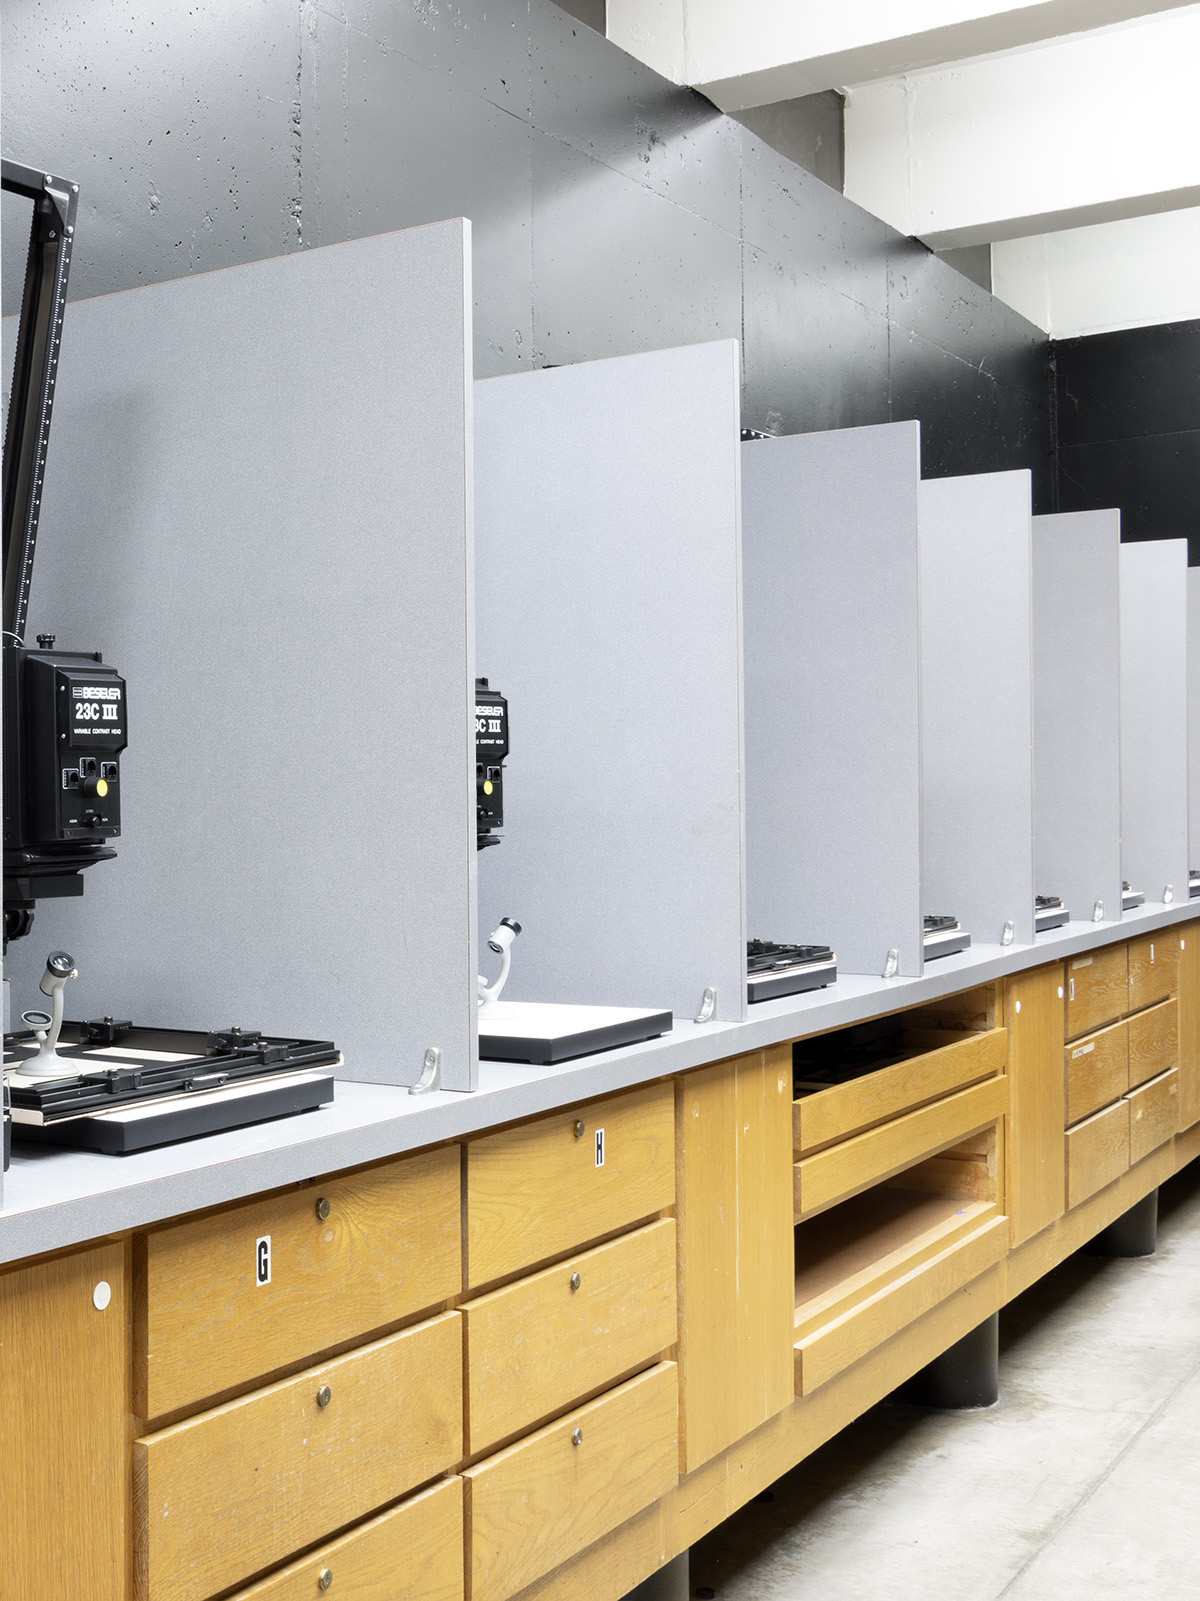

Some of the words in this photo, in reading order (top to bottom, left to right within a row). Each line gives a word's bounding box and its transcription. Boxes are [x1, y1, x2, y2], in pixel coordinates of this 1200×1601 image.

[82, 686, 121, 700] BESELER
[75, 702, 100, 720] 23C
[101, 703, 118, 720] III
[475, 718, 487, 733] 3C
[488, 719, 501, 733] III
[596, 1131, 603, 1165] H
[258, 1240, 268, 1282] G
